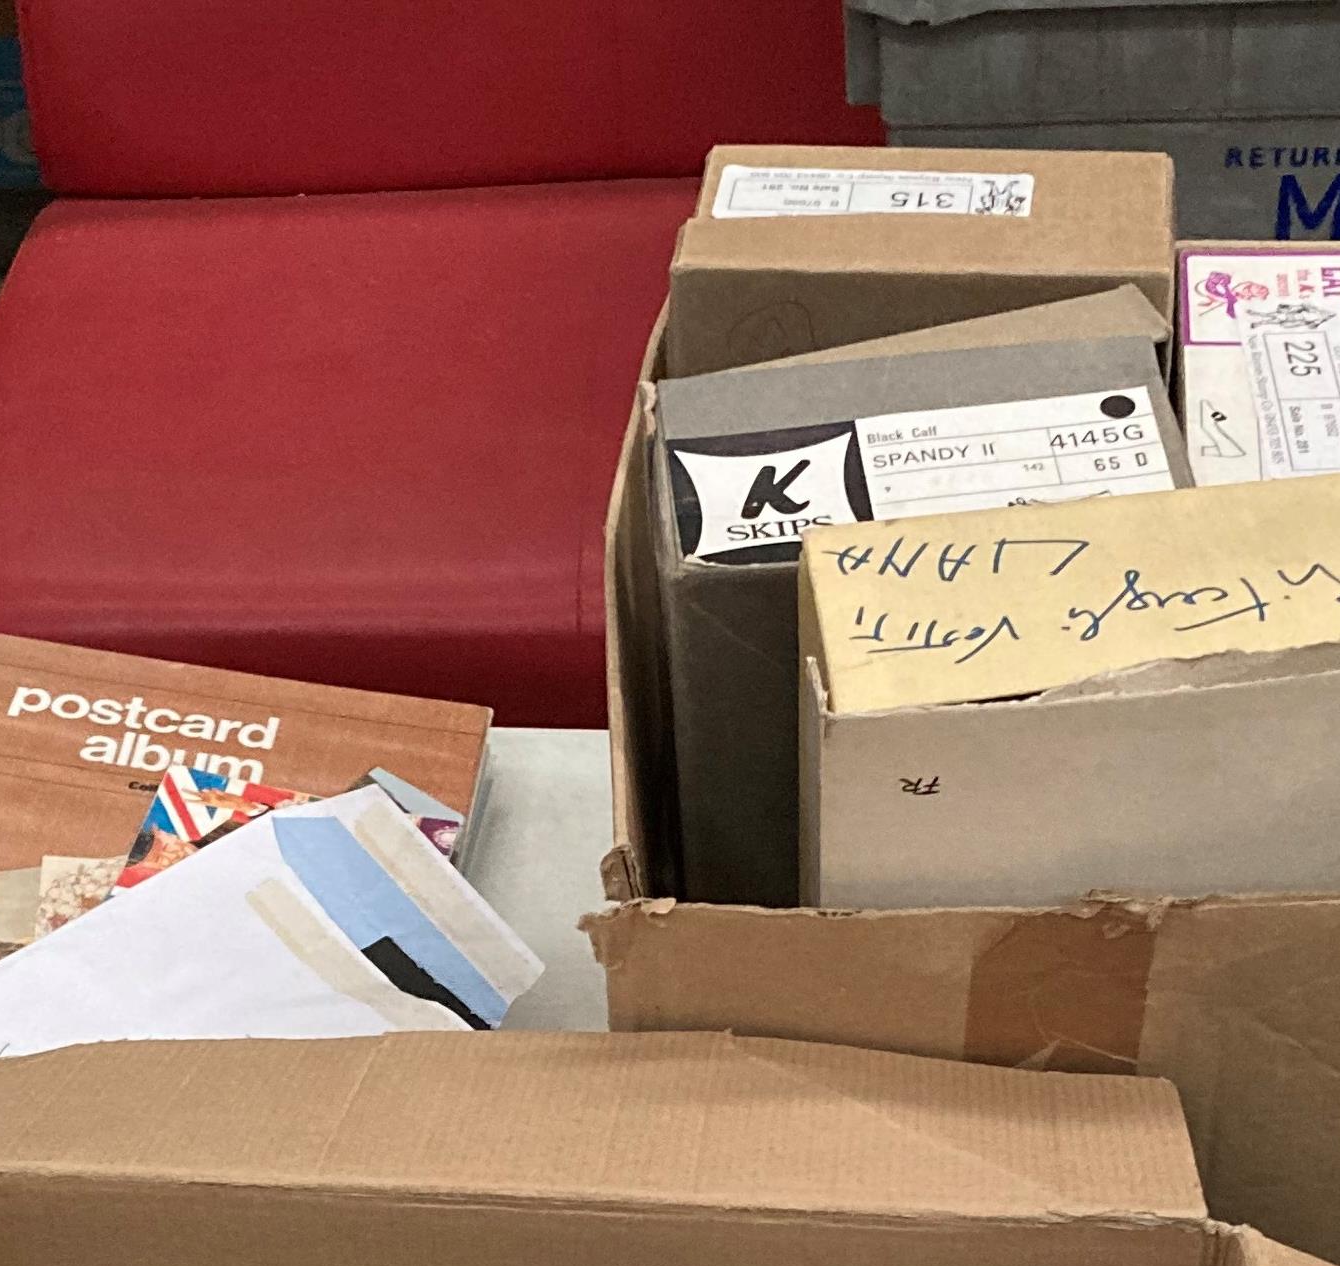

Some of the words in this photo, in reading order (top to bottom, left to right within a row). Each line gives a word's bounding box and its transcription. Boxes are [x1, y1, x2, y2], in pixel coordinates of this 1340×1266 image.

[890, 192, 956, 210] 315
[1284, 340, 1322, 377] 225
[866, 429, 905, 444] Black
[911, 425, 939, 439] Calf
[1049, 423, 1145, 451] 4145G
[873, 444, 970, 469] SPANDY
[1094, 456, 1122, 472] 65
[740, 459, 811, 519] K
[7, 685, 281, 751] postcard
[79, 731, 265, 785] album
